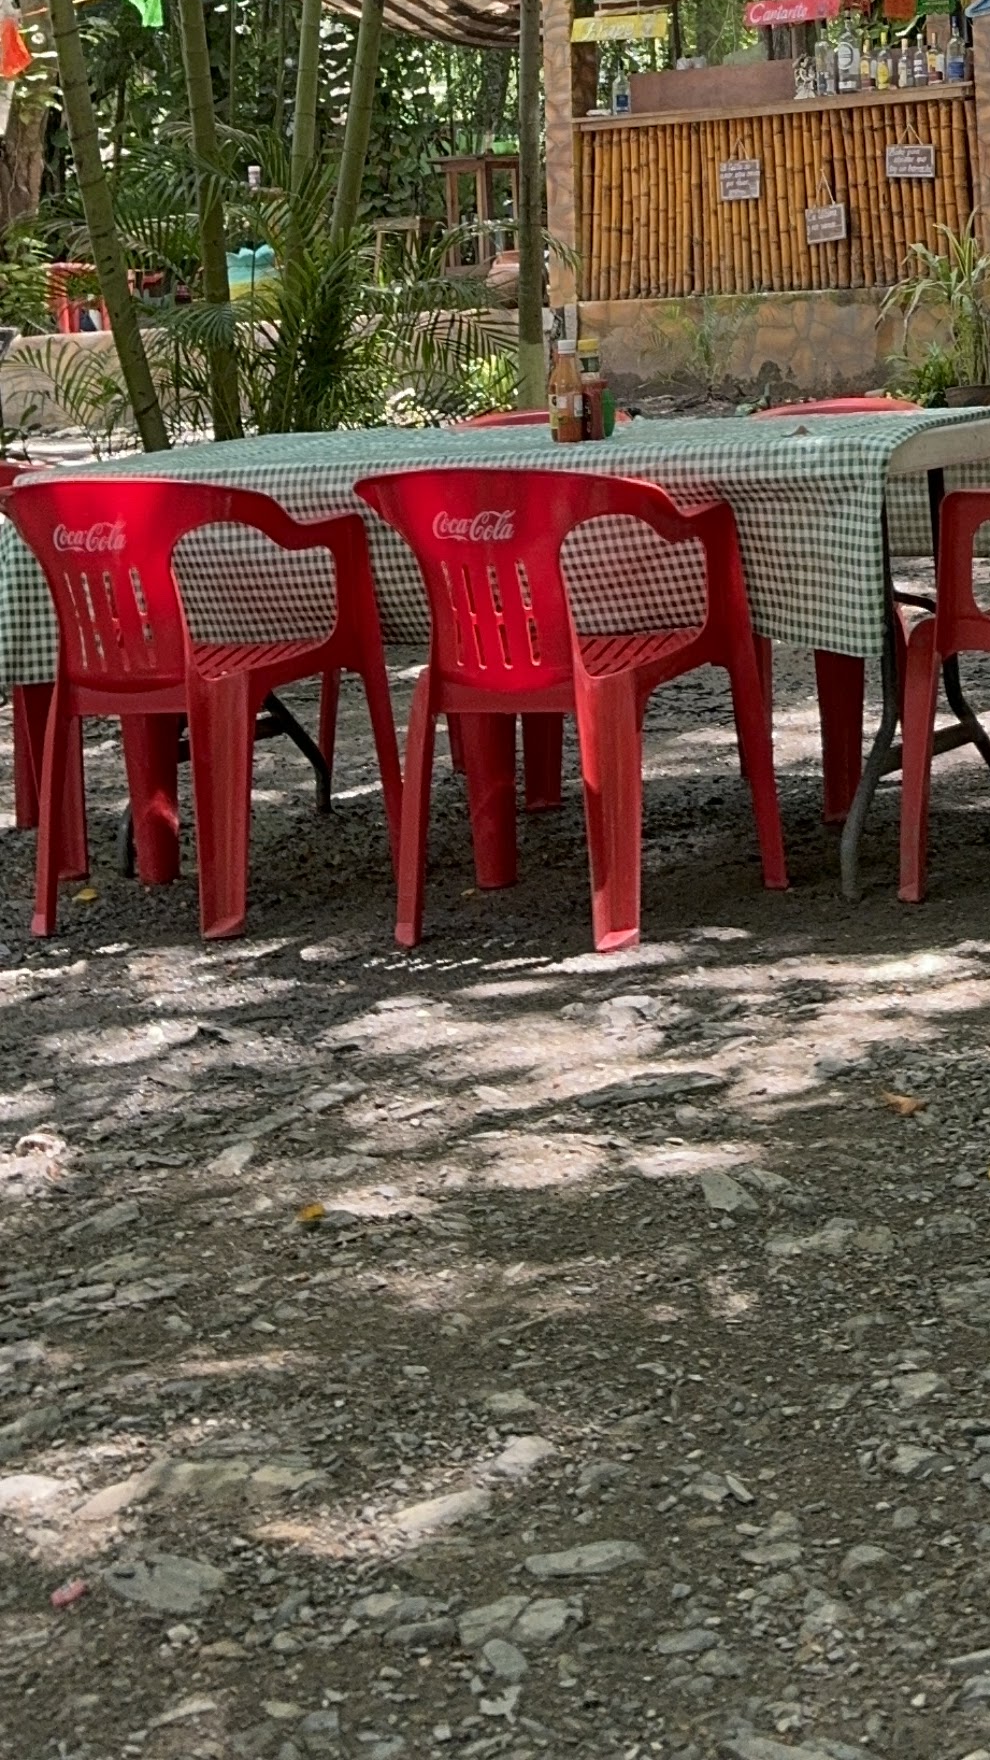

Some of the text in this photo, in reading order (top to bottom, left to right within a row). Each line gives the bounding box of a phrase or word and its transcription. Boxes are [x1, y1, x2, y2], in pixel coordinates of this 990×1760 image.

[750, 3, 808, 24] Cantarito
[53, 518, 127, 553] Coca-Cola
[432, 510, 517, 542] Coca-Cola
